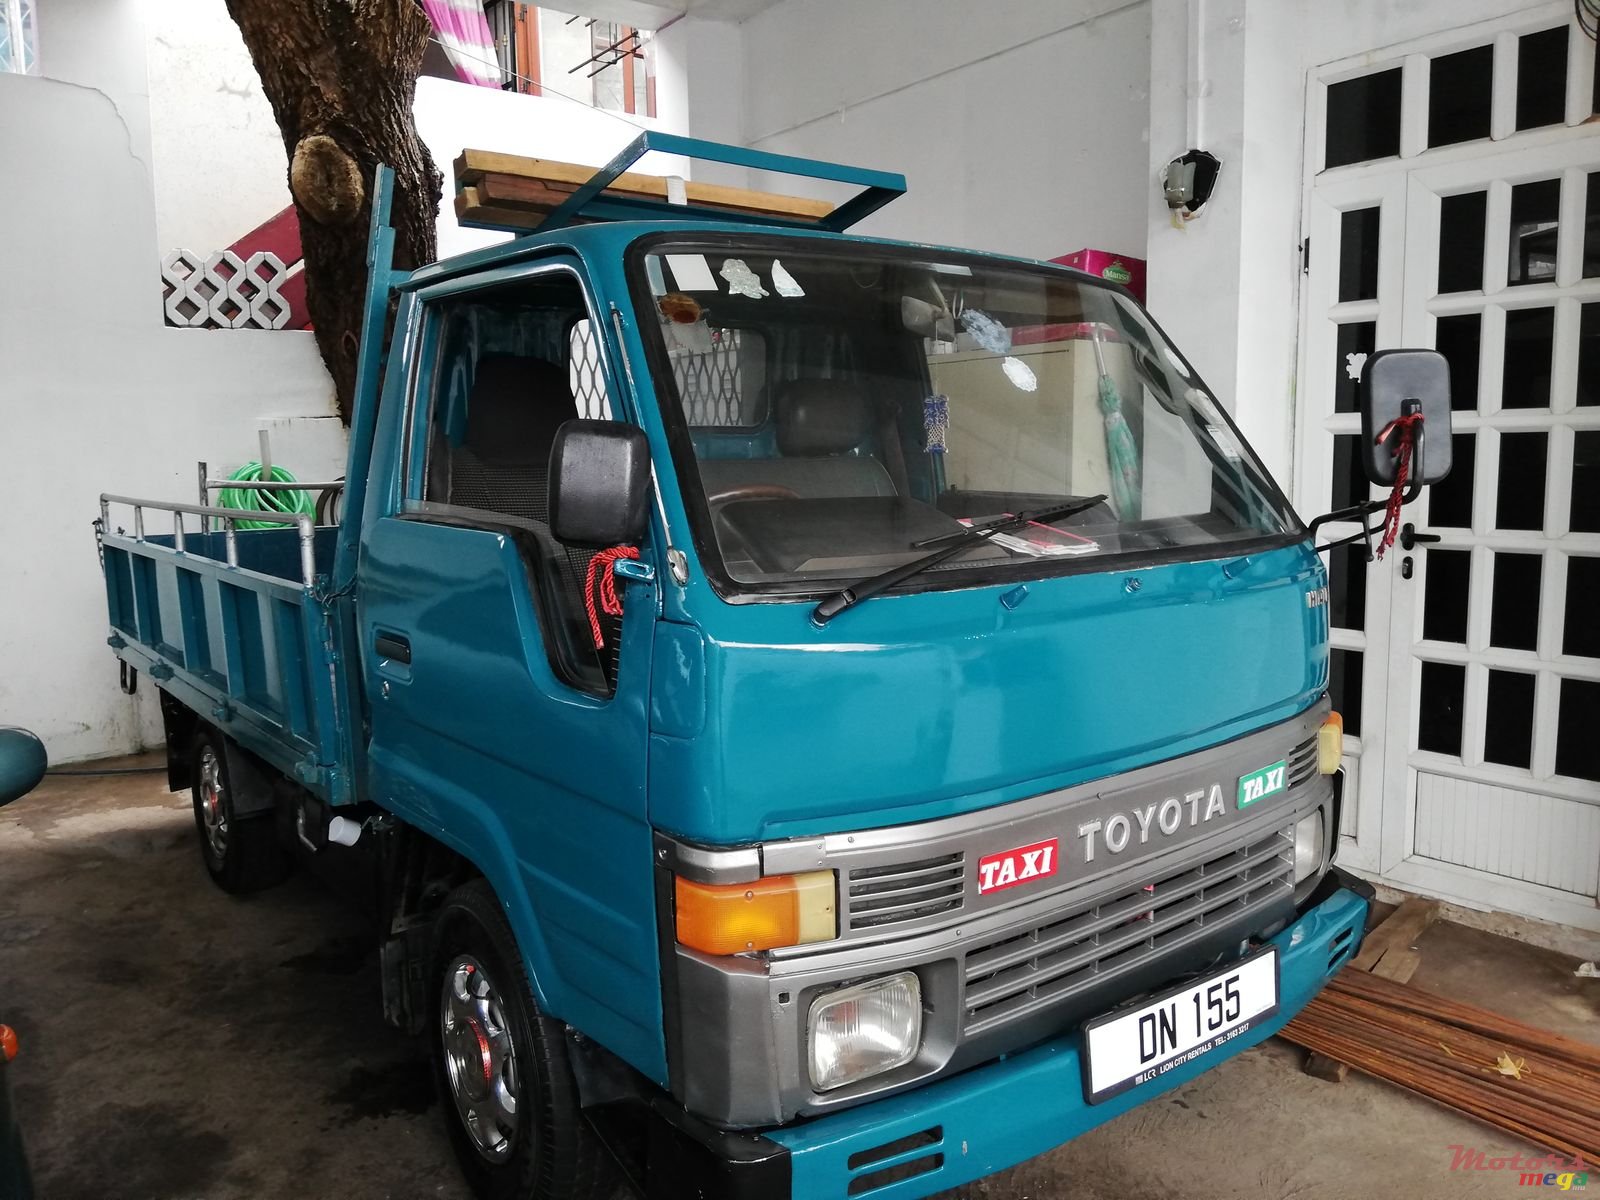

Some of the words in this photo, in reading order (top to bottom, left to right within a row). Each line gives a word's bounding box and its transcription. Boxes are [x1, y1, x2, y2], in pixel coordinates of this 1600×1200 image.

[1242, 765, 1285, 804] TAXI
[1078, 784, 1225, 863] TOYOTA
[980, 845, 1054, 891] TAXI
[1139, 1003, 1176, 1063] DN
[1193, 975, 1240, 1038] 155
[1144, 1070, 1156, 1081] LCR
[1159, 1061, 1174, 1075] LION
[1174, 1055, 1188, 1067] CITY
[1187, 1042, 1212, 1060] RENTALS
[1214, 1036, 1227, 1047] TEL:
